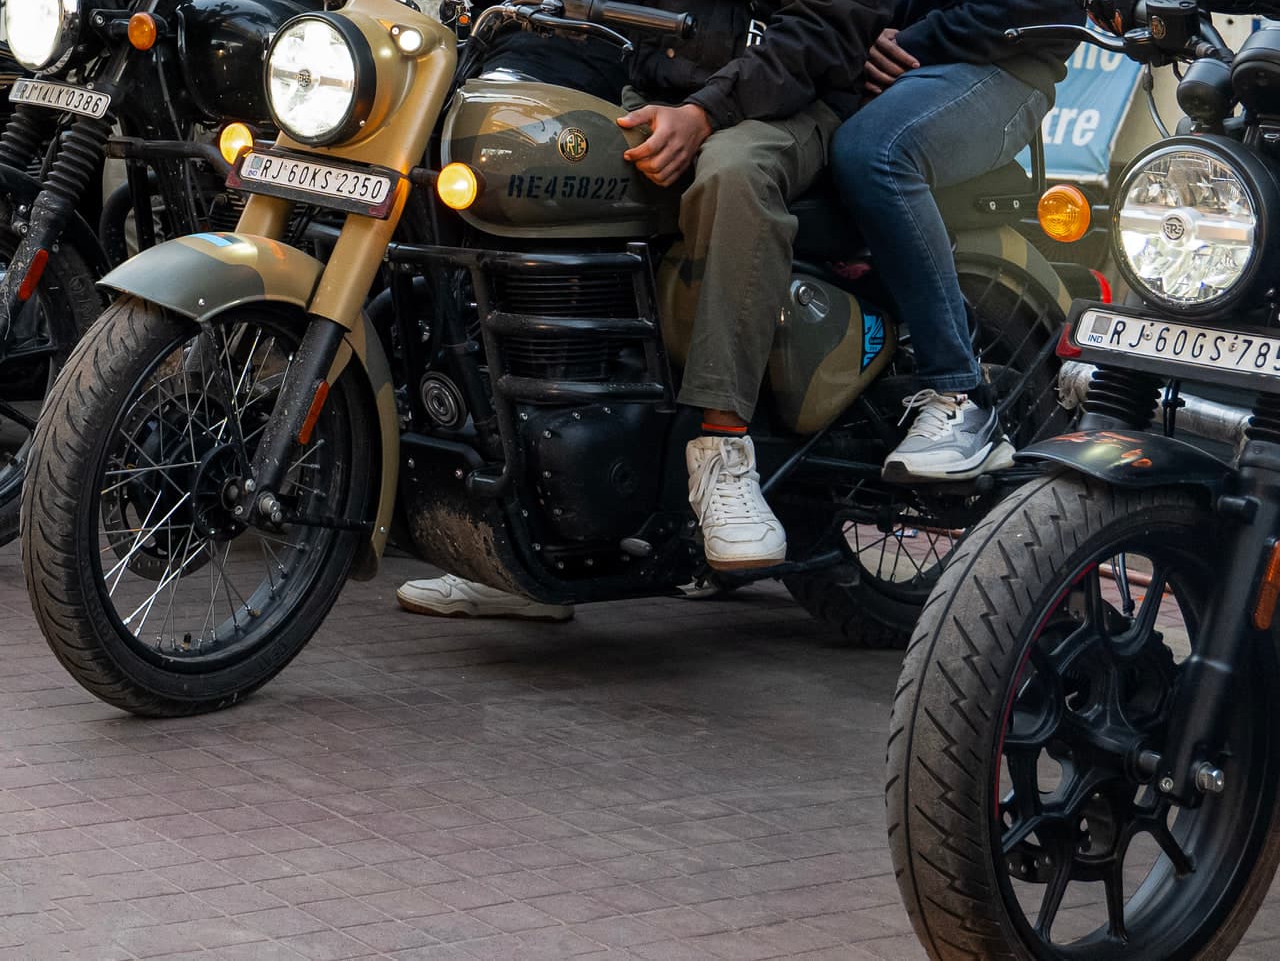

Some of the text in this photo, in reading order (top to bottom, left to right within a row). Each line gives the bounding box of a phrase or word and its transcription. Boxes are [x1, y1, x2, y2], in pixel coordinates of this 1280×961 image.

[65, 90, 103, 114] 0386
[287, 164, 333, 190] 60KS
[336, 173, 383, 199] 2350
[508, 174, 631, 200] RE458227
[1087, 334, 1104, 344] IND
[1109, 319, 1146, 348] RJ
[1155, 326, 1227, 362] 60GS
